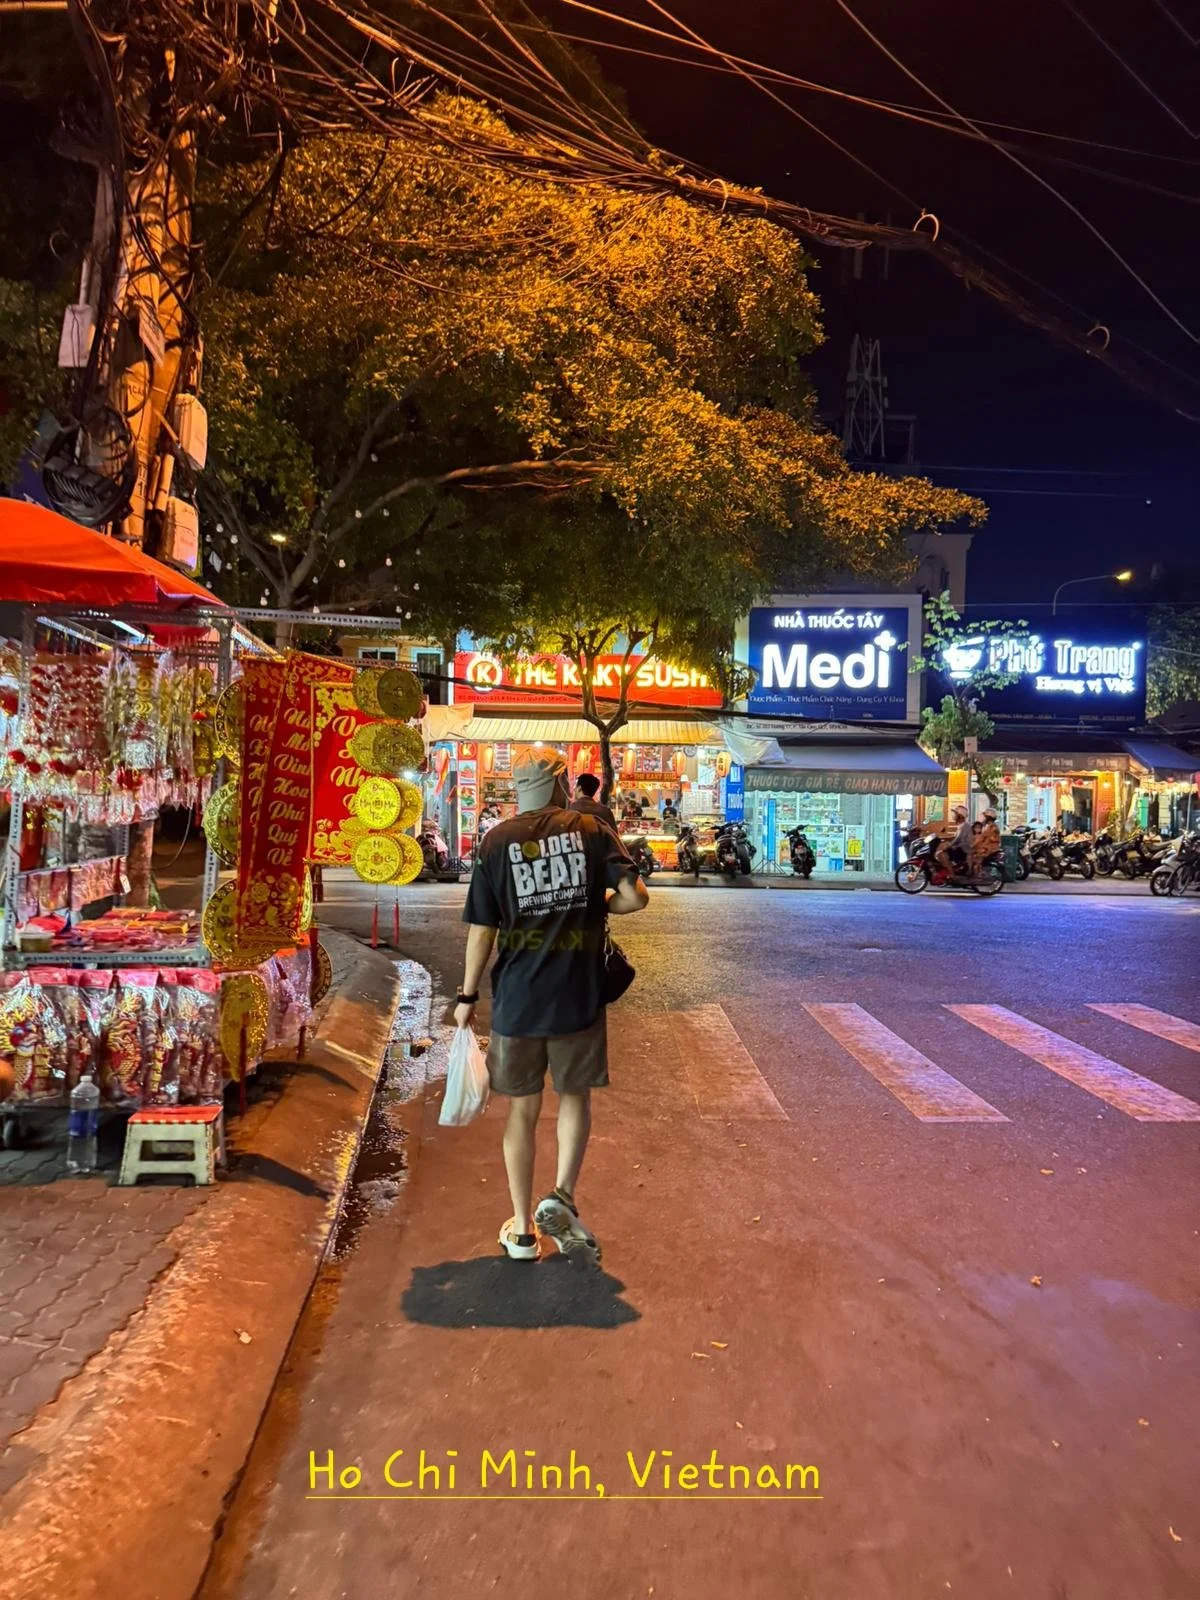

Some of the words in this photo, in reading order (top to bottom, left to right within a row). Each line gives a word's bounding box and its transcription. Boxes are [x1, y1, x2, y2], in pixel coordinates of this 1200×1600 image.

[774, 610, 805, 628] NHÀ
[808, 609, 855, 628] THUỐC
[857, 612, 883, 628] TÂY
[762, 630, 896, 689] Medi
[1054, 640, 1136, 679] Trang
[514, 663, 557, 687] THE
[562, 663, 632, 688] KKY
[636, 663, 714, 688] SUSH
[273, 777, 309, 798] Hoa
[511, 852, 588, 897] BEAR
[518, 891, 552, 908] BREWING
[553, 886, 588, 901] COMPANY
